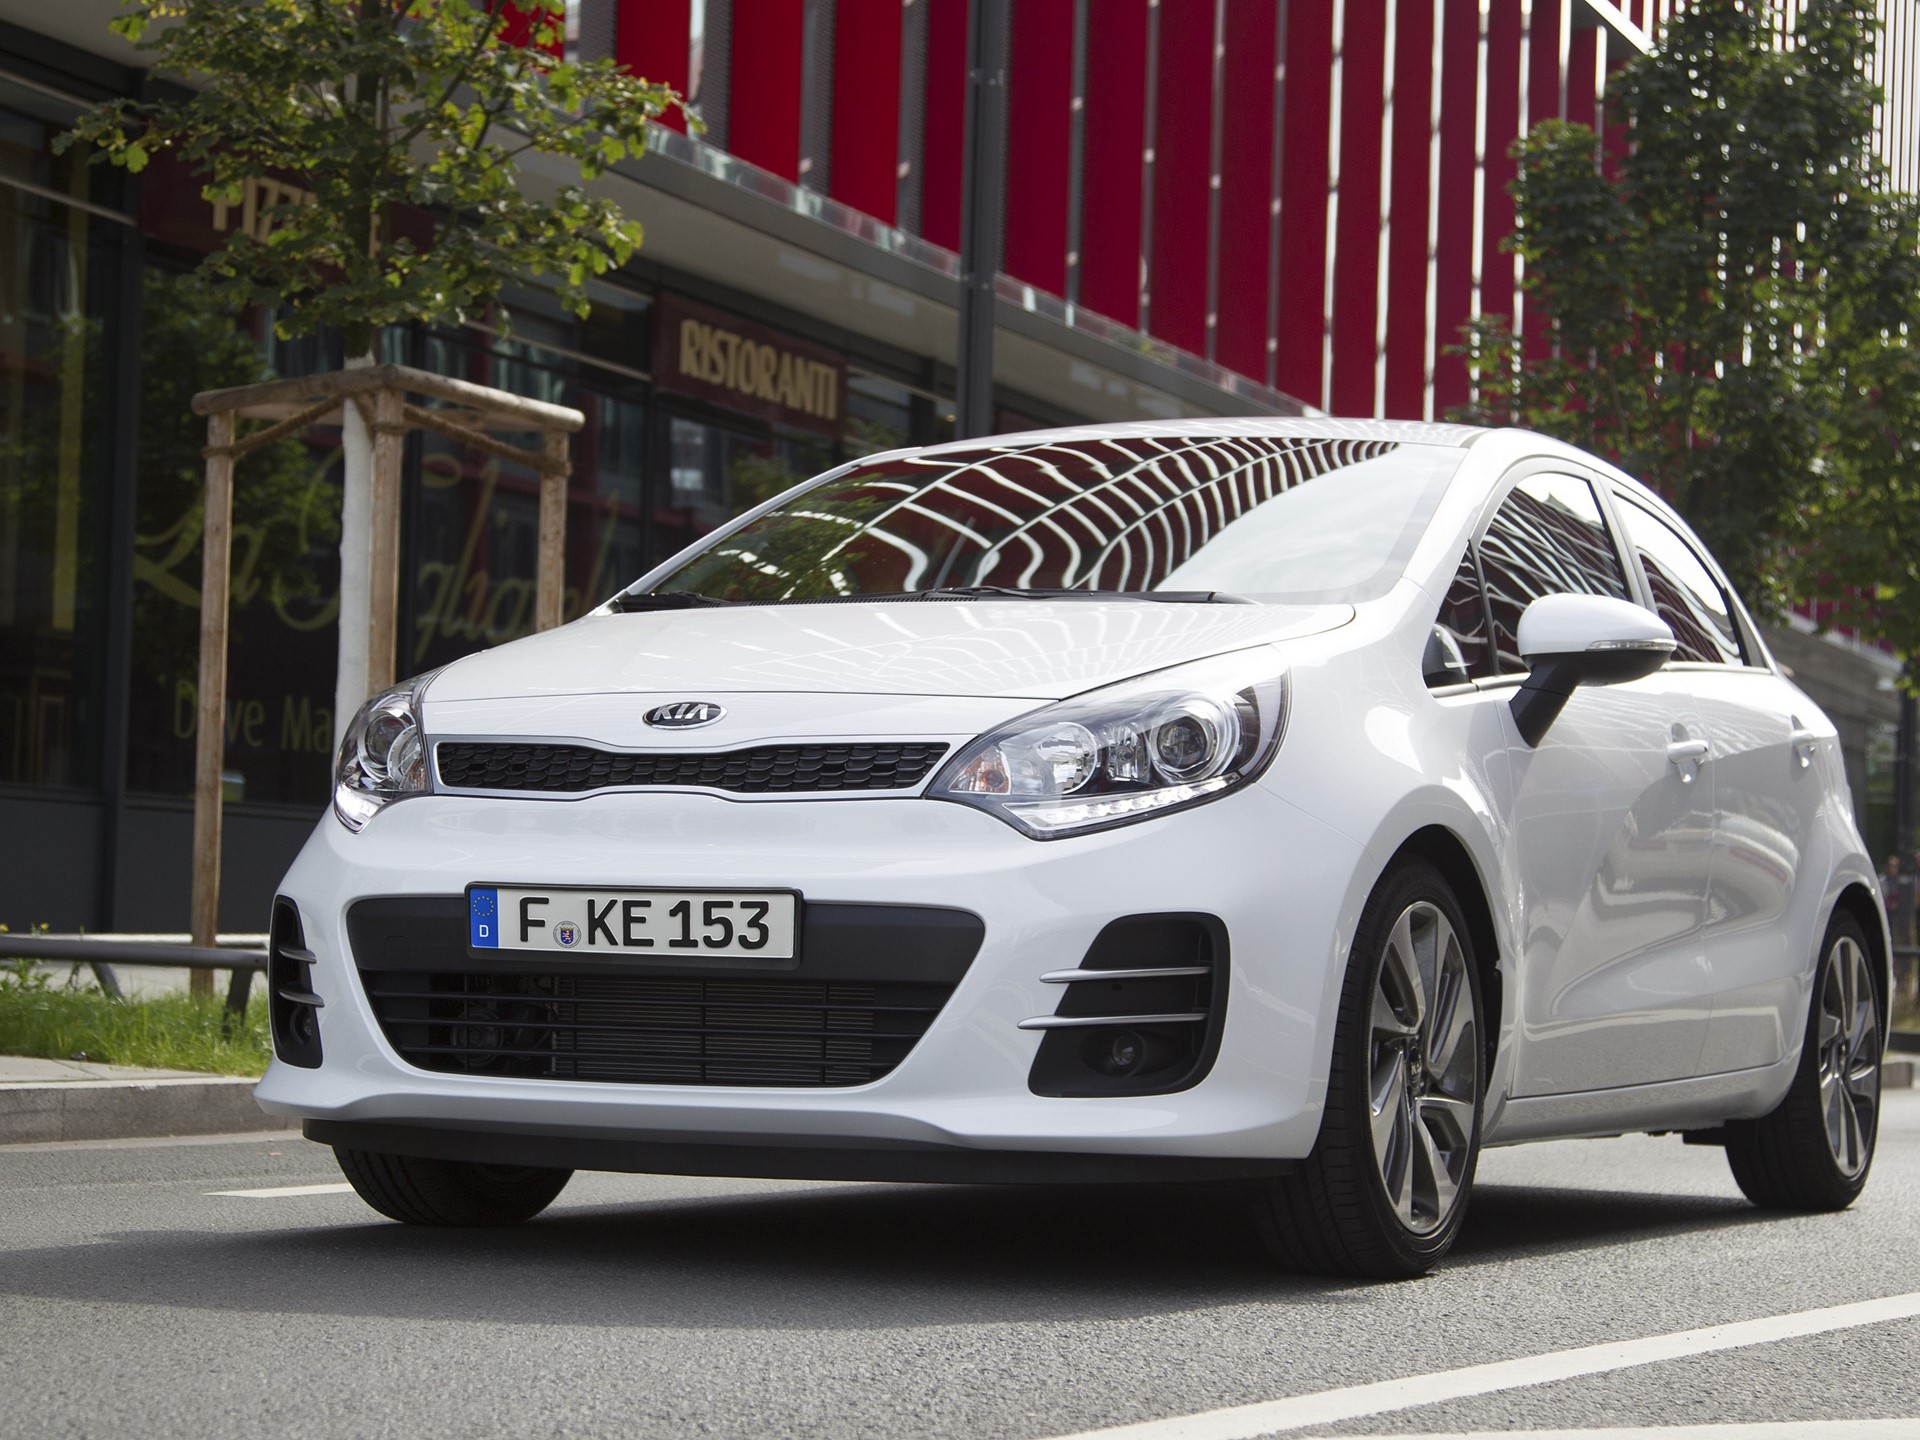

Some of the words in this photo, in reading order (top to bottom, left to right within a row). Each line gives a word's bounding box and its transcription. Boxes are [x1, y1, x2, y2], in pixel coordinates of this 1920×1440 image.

[680, 319, 838, 420] RISTORANTI
[173, 679, 266, 747] Dve
[652, 703, 709, 721] KIA
[479, 924, 489, 938] D
[519, 896, 550, 943] F
[587, 898, 655, 948] KE
[668, 899, 770, 950] 153
